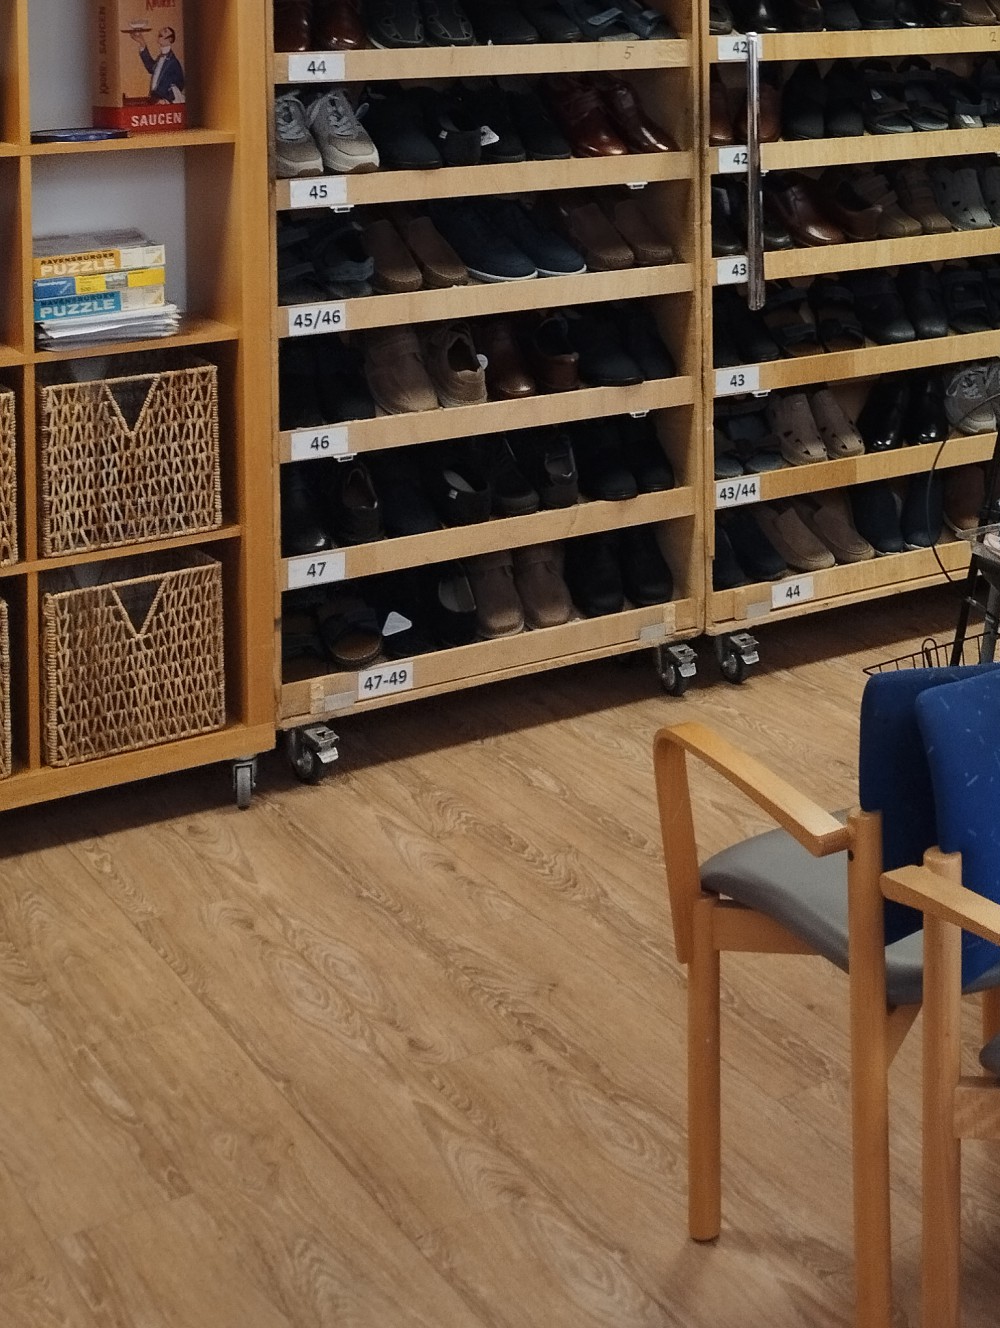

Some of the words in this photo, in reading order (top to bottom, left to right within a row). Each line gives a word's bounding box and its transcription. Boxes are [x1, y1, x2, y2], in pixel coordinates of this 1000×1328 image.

[733, 41, 748, 53] 42
[307, 60, 326, 75] 44
[131, 112, 182, 128] SAUCEN
[733, 152, 748, 165] 42
[309, 184, 328, 200] 45
[40, 252, 115, 265] RAVENSBURGER
[40, 259, 116, 277] PUZZLE
[732, 263, 747, 276] 43
[40, 299, 115, 319] PUZZLE
[293, 309, 342, 329] 45/46
[730, 374, 745, 387] 43
[310, 435, 330, 450] 46
[719, 483, 757, 501] 43/44
[307, 562, 327, 578] 47
[785, 585, 801, 598] 44
[363, 670, 408, 690] 47-49
